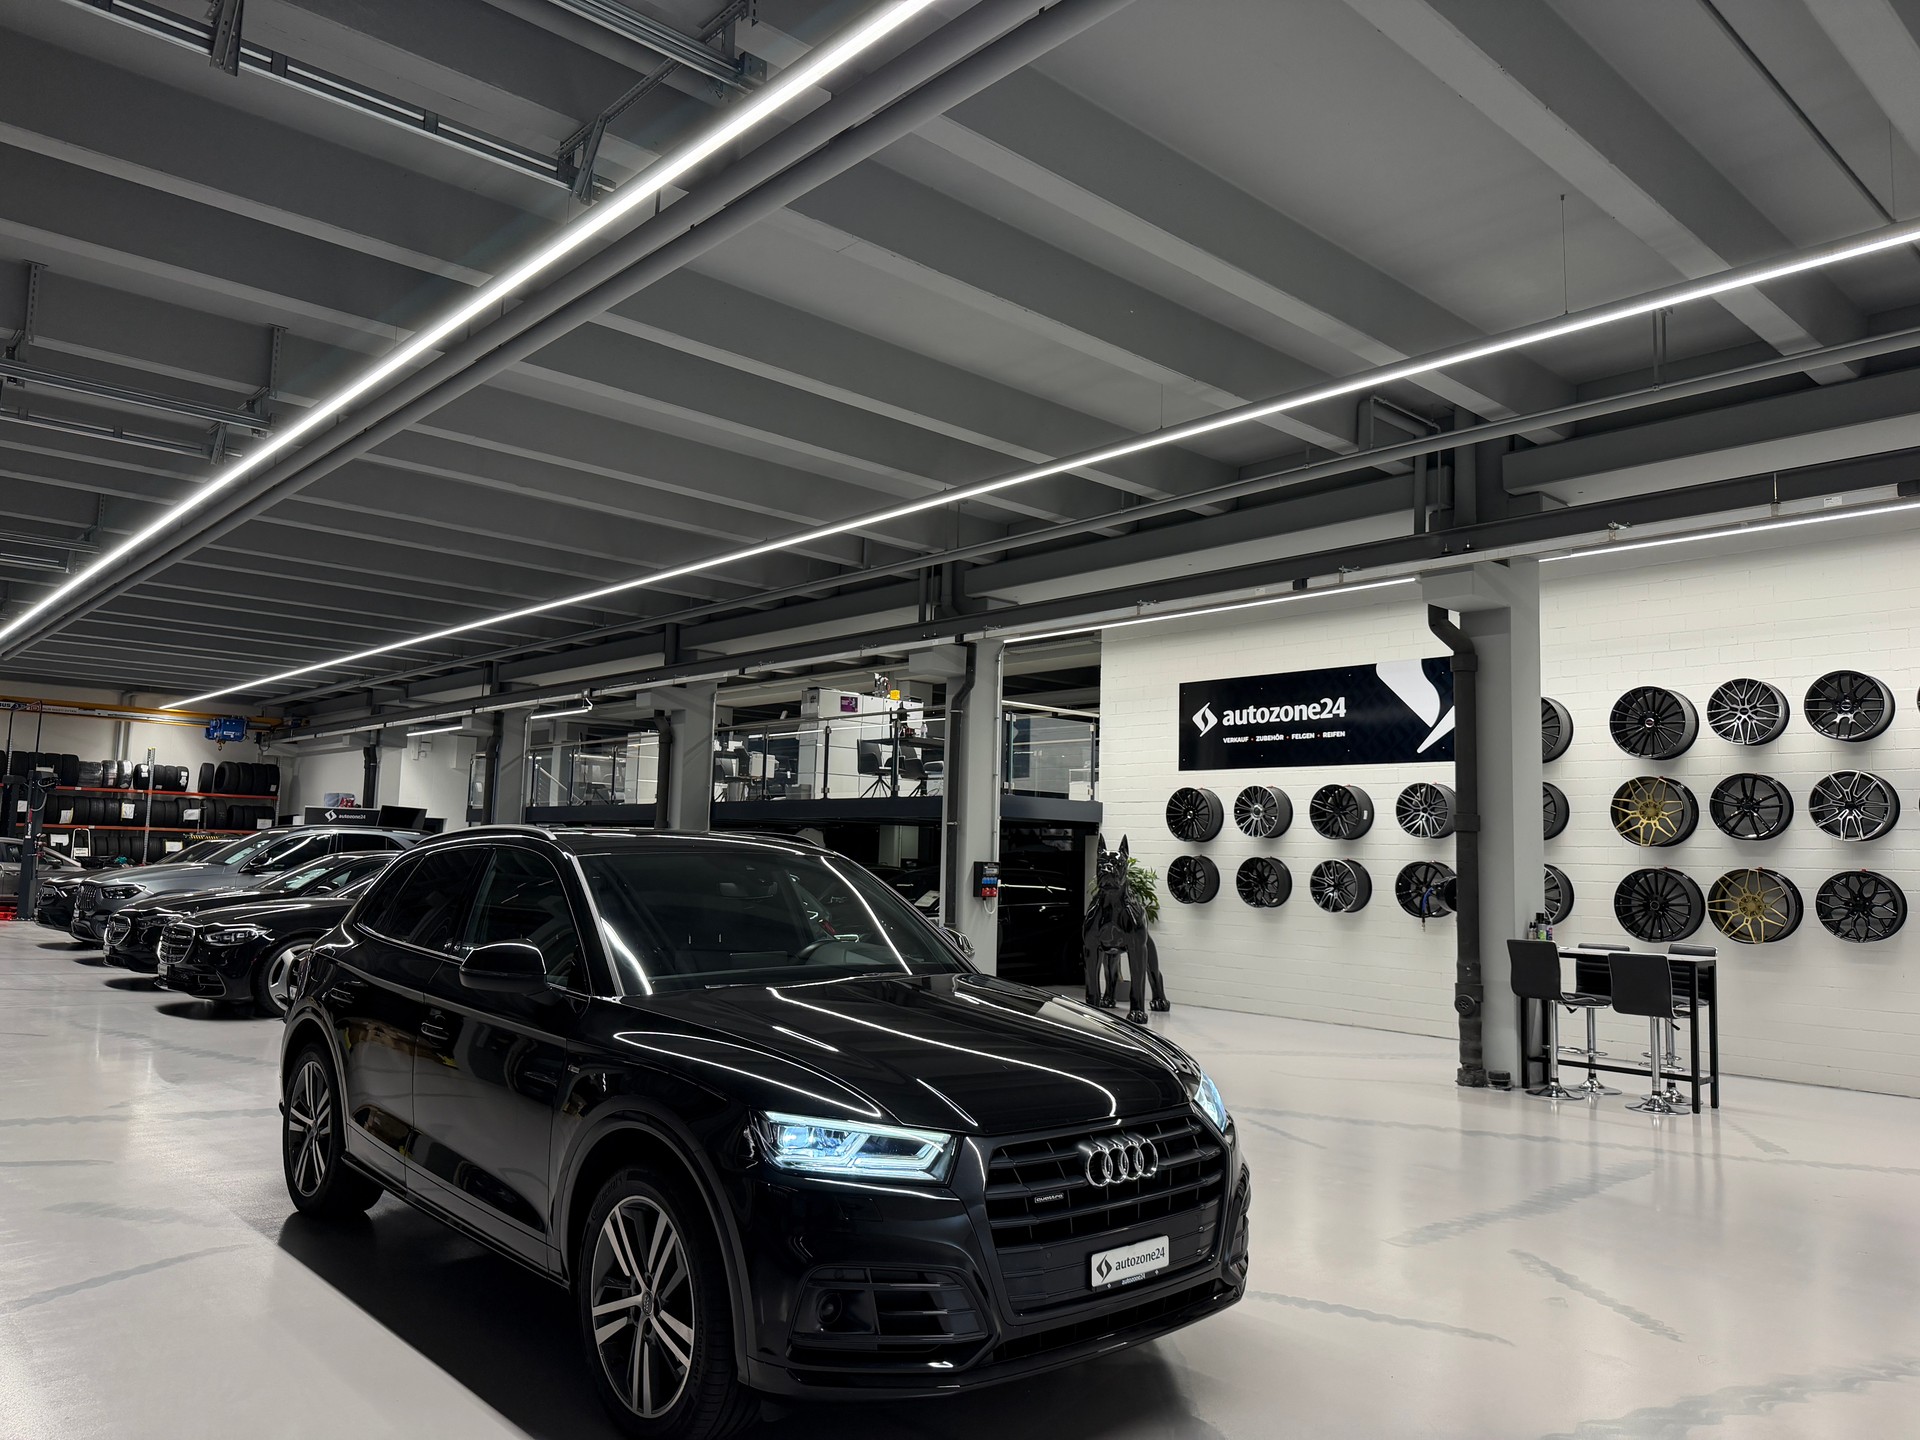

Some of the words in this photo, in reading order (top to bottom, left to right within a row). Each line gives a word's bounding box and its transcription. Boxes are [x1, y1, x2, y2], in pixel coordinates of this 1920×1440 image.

[1222, 697, 1346, 726] autozone24
[1255, 733, 1284, 741] ZUBEHÖR
[1291, 732, 1315, 740] FELGEN
[1115, 1246, 1165, 1271] autozone24
[1122, 1272, 1146, 1285] autozone24
